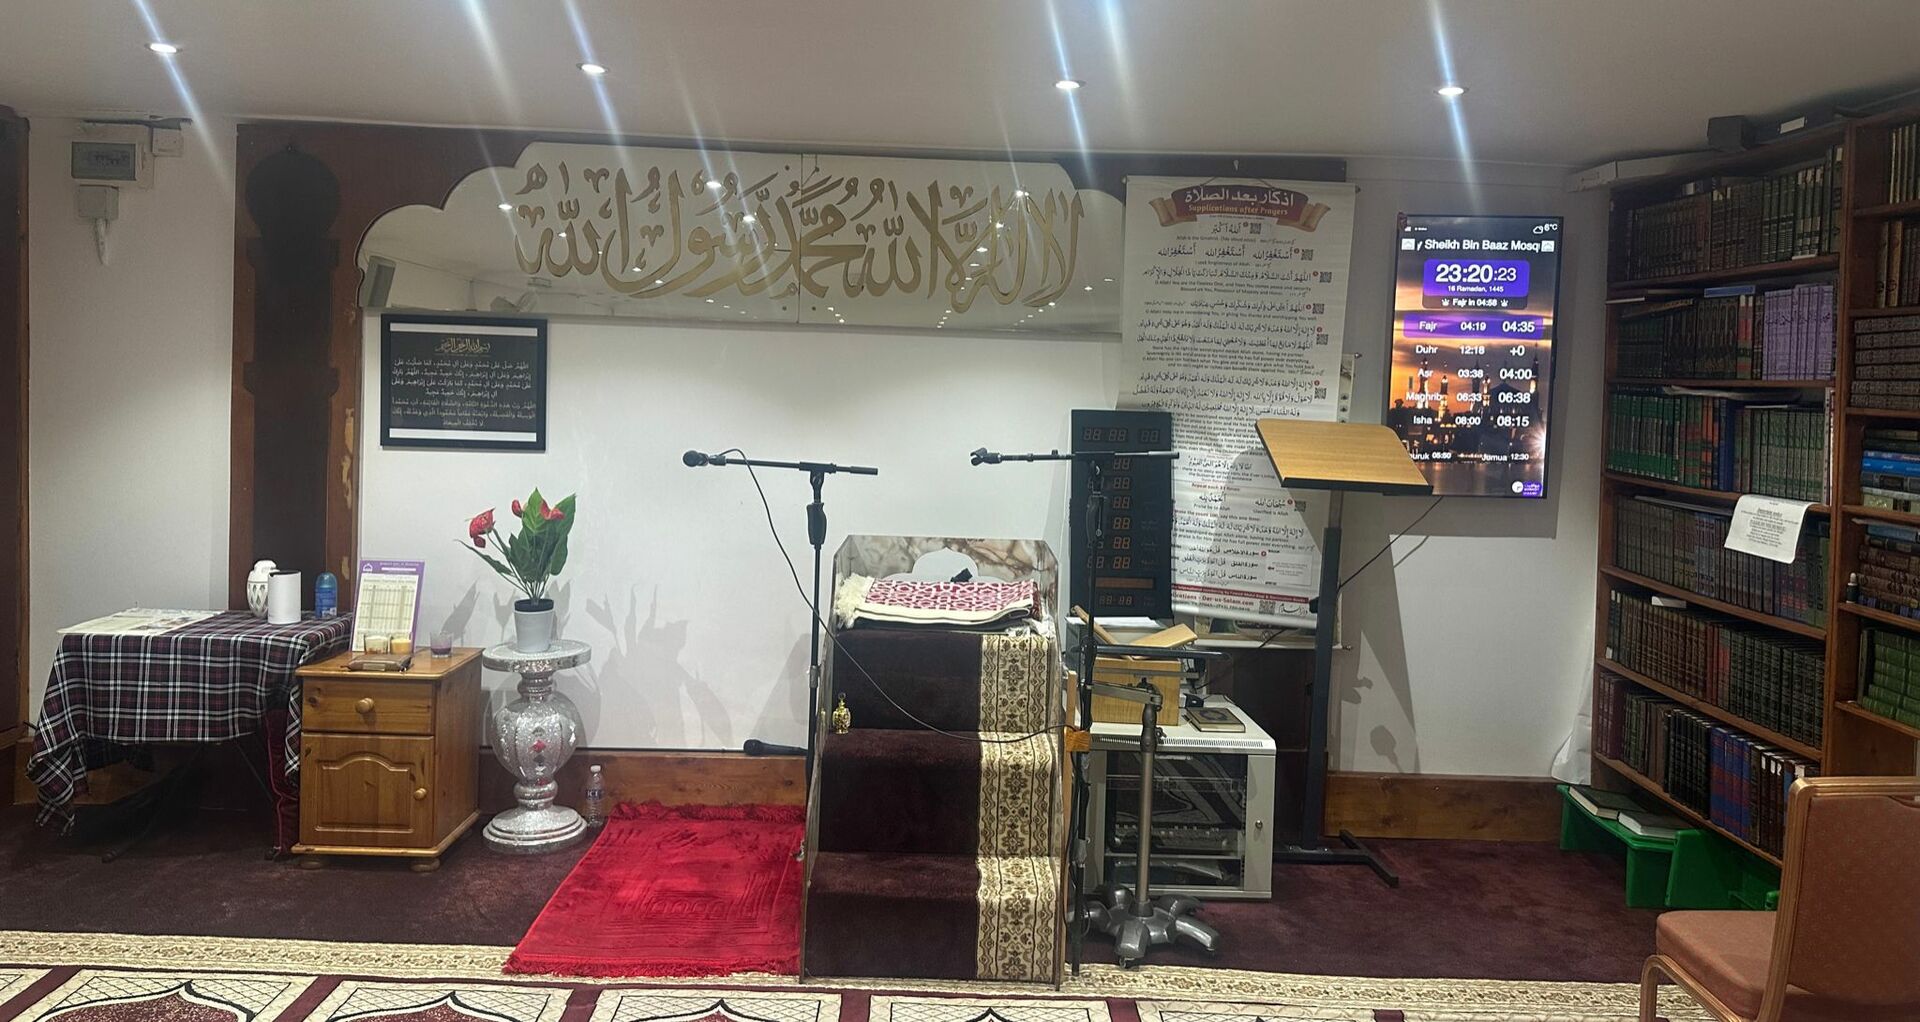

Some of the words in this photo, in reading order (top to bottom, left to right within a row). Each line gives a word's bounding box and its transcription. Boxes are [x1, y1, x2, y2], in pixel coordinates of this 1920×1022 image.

[1185, 187, 1229, 203] الصلاة
[1232, 190, 1258, 206] بعد
[1188, 204, 1238, 213] Supplications
[1239, 206, 1259, 214] after
[1260, 207, 1288, 216] Prayers
[1424, 238, 1460, 250] Sheikh
[1462, 239, 1480, 250] Bin
[1482, 239, 1508, 250] Baaz
[1511, 240, 1541, 253] Mosq
[1419, 321, 1437, 332] Fajr
[1460, 322, 1486, 331] 04:19
[1502, 321, 1535, 333] 04:35
[1415, 345, 1439, 354] Duhr
[1459, 345, 1485, 354] 12:18
[1509, 345, 1525, 356] +0
[1417, 368, 1433, 377] Asr
[1457, 368, 1484, 378] 03:38
[1499, 368, 1532, 380] 04:00
[1406, 392, 1443, 402] Maghrib
[1456, 392, 1482, 401] 06:33
[1498, 392, 1531, 404] 06:38
[1413, 415, 1433, 425] Isha
[1455, 416, 1481, 425] 08:00
[1496, 415, 1530, 427] 08:15
[1409, 452, 1430, 460] uruk
[1481, 453, 1507, 462] Jumua
[1510, 453, 1529, 461] 12:30
